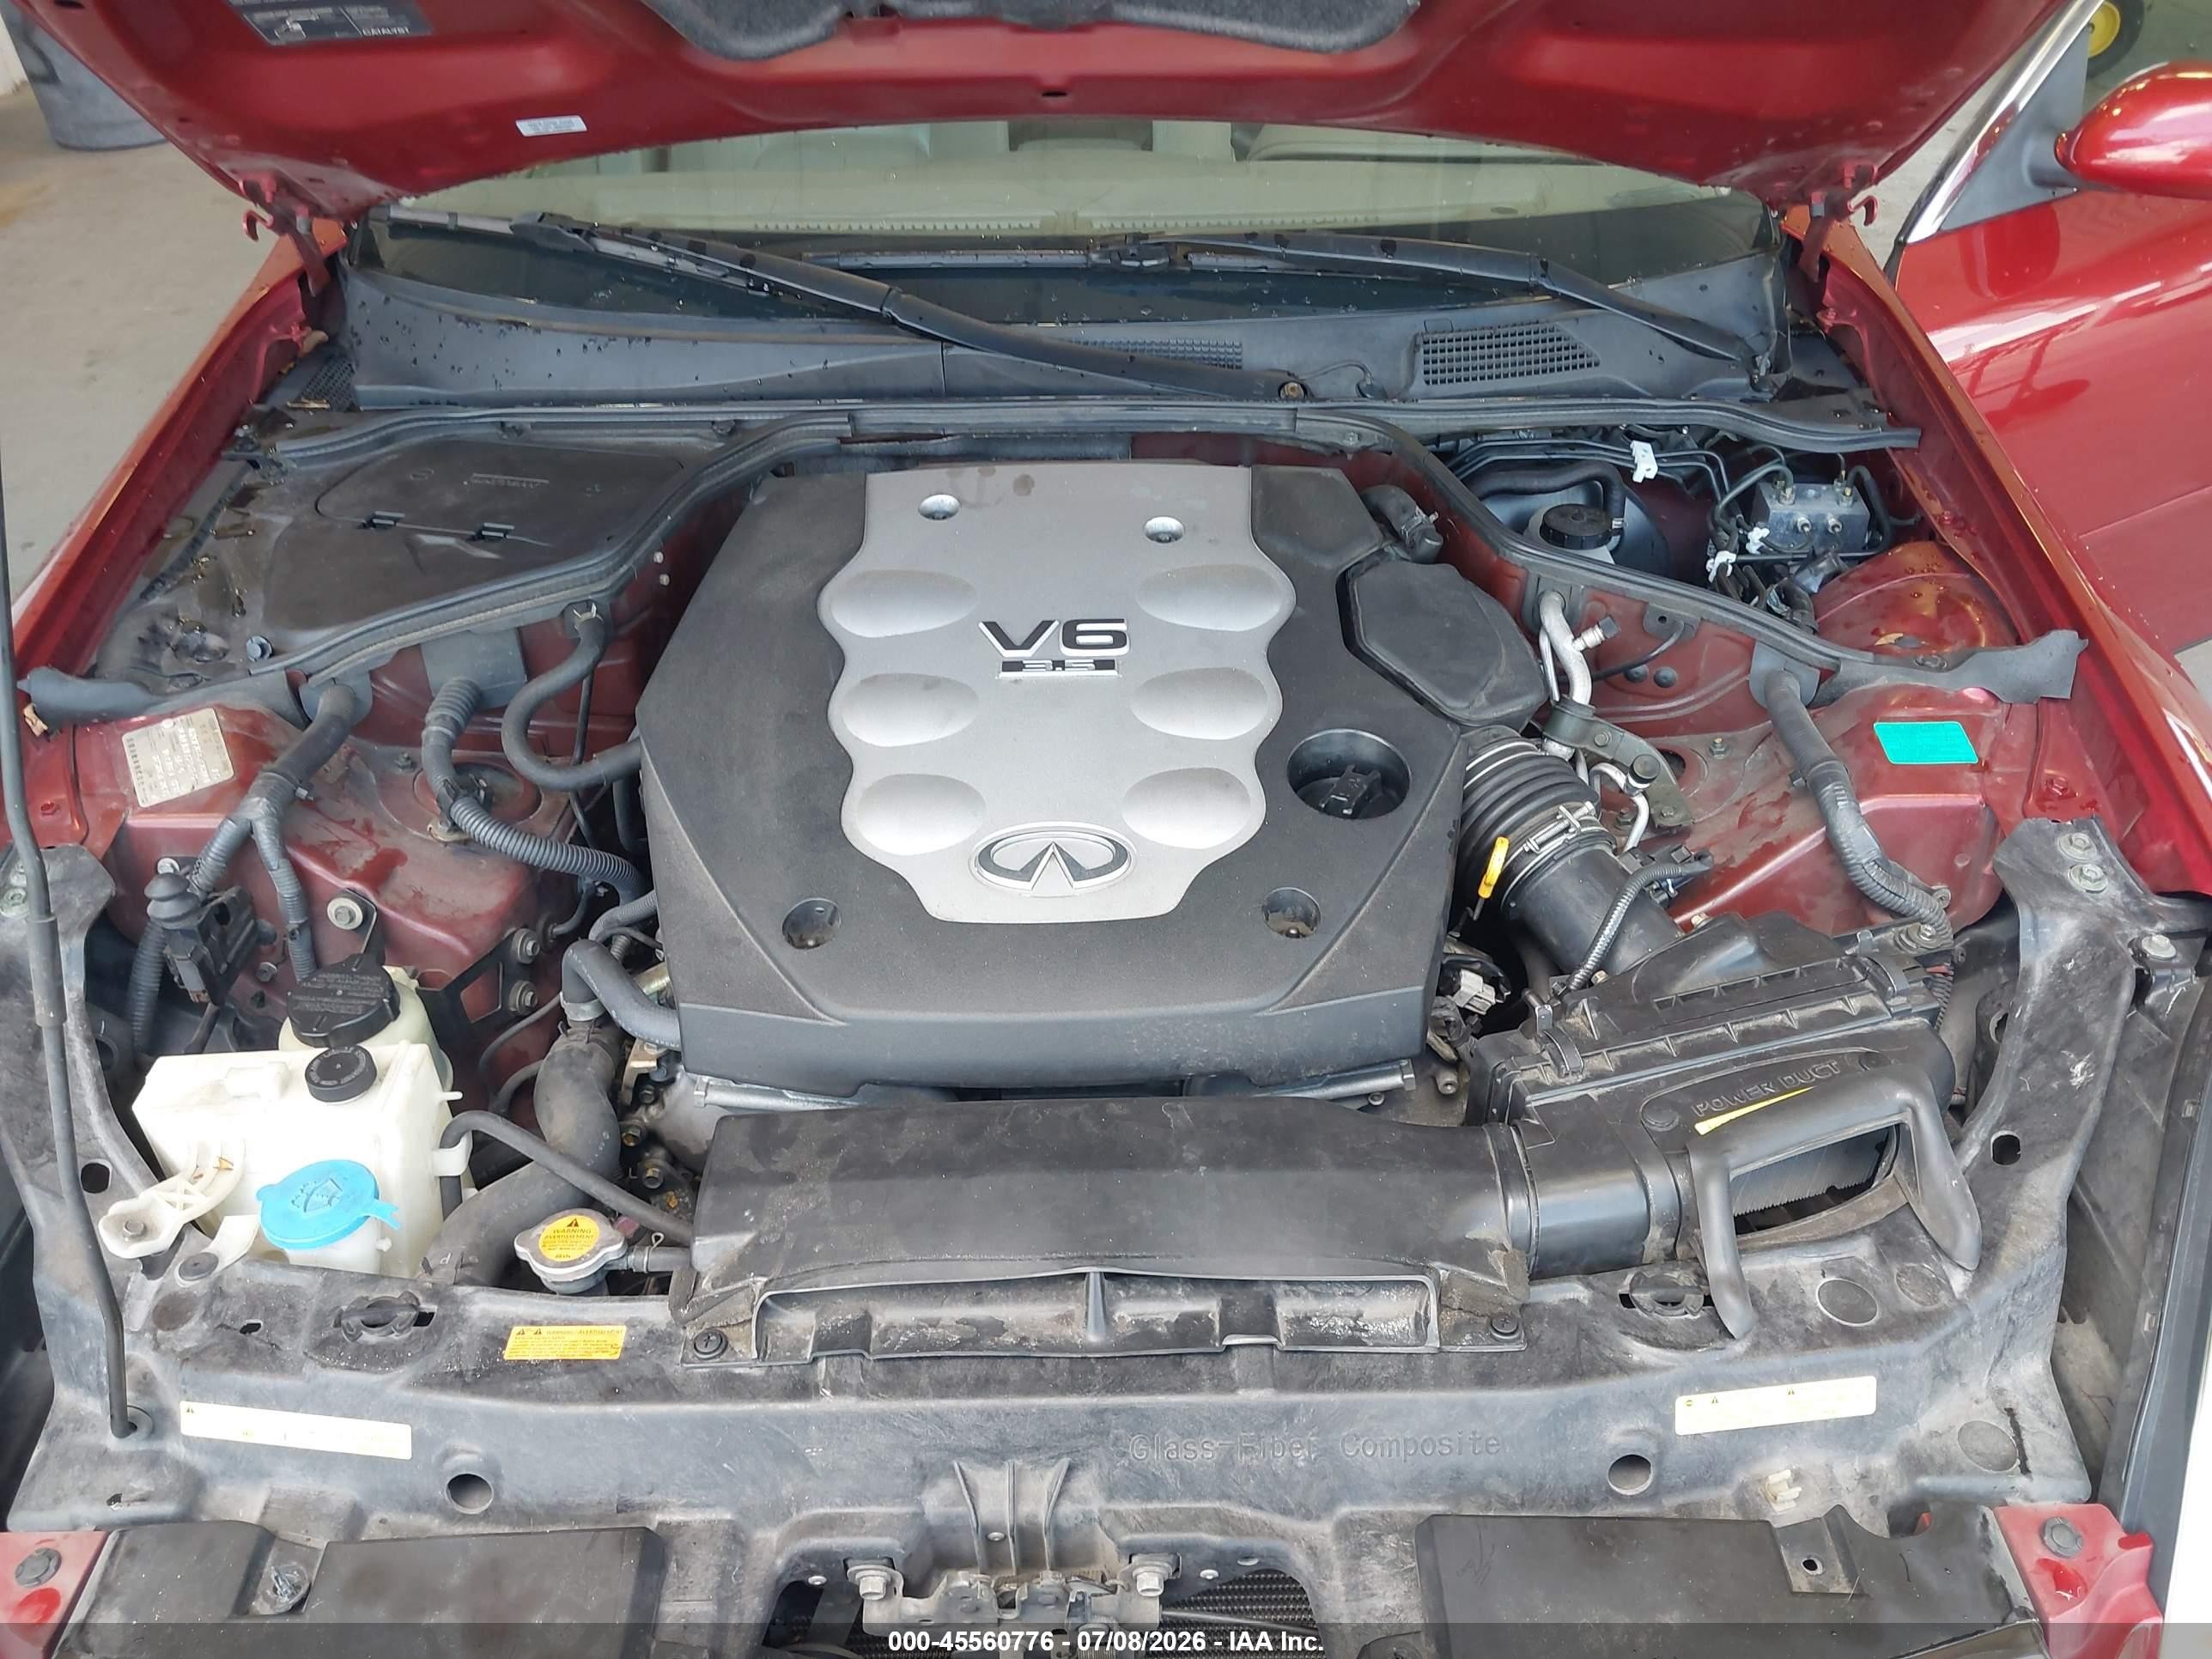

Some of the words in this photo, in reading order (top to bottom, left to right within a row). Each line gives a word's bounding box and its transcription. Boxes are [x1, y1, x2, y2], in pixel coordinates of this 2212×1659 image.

[978, 618, 1130, 658] V6
[1021, 659, 1097, 672] 3.5
[1690, 1081, 1779, 1117] POWER
[1778, 1059, 1842, 1089] DUCT
[1129, 1432, 1319, 1462] Glass-Fiber
[1340, 1430, 1504, 1462] Composite
